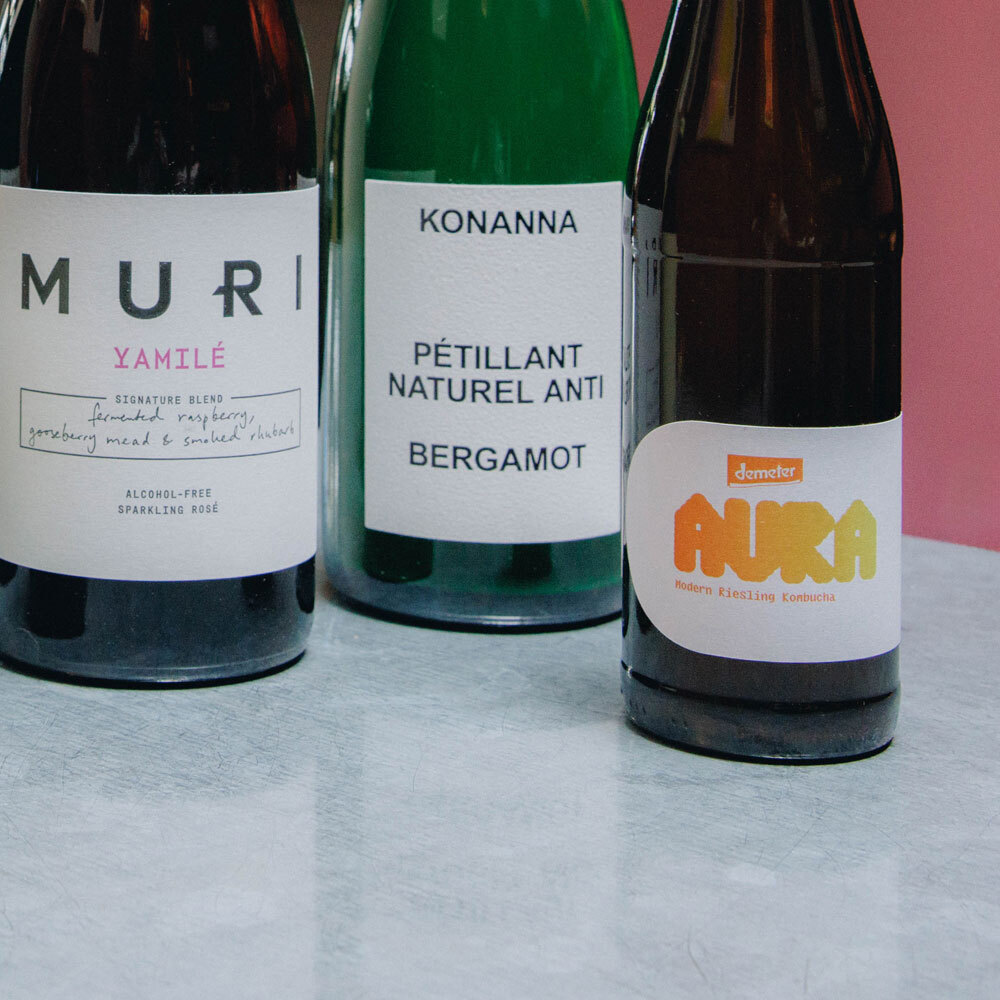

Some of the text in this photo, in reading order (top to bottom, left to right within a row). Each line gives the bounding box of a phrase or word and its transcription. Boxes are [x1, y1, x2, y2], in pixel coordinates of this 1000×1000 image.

[420, 208, 578, 234] KONANNA
[21, 253, 302, 320] MURI
[114, 341, 225, 370] YAMILÉ
[414, 338, 582, 370] PÉTILLANT
[116, 394, 222, 404] SIGNATURE BLEND
[390, 372, 604, 404] NATUREL ANTI
[88, 402, 164, 427] fermented
[29, 424, 96, 453] gooseberry
[106, 432, 150, 446] mead
[184, 426, 240, 446] smoked
[250, 420, 294, 441] rhubarb
[410, 442, 586, 472] BERGAMOT
[735, 462, 796, 480] demeter
[126, 489, 212, 500] ALCOHOL-FREE
[118, 502, 218, 515] SPARKLING ROSÉ
[675, 580, 836, 603] Modern Riesling Kombucha
